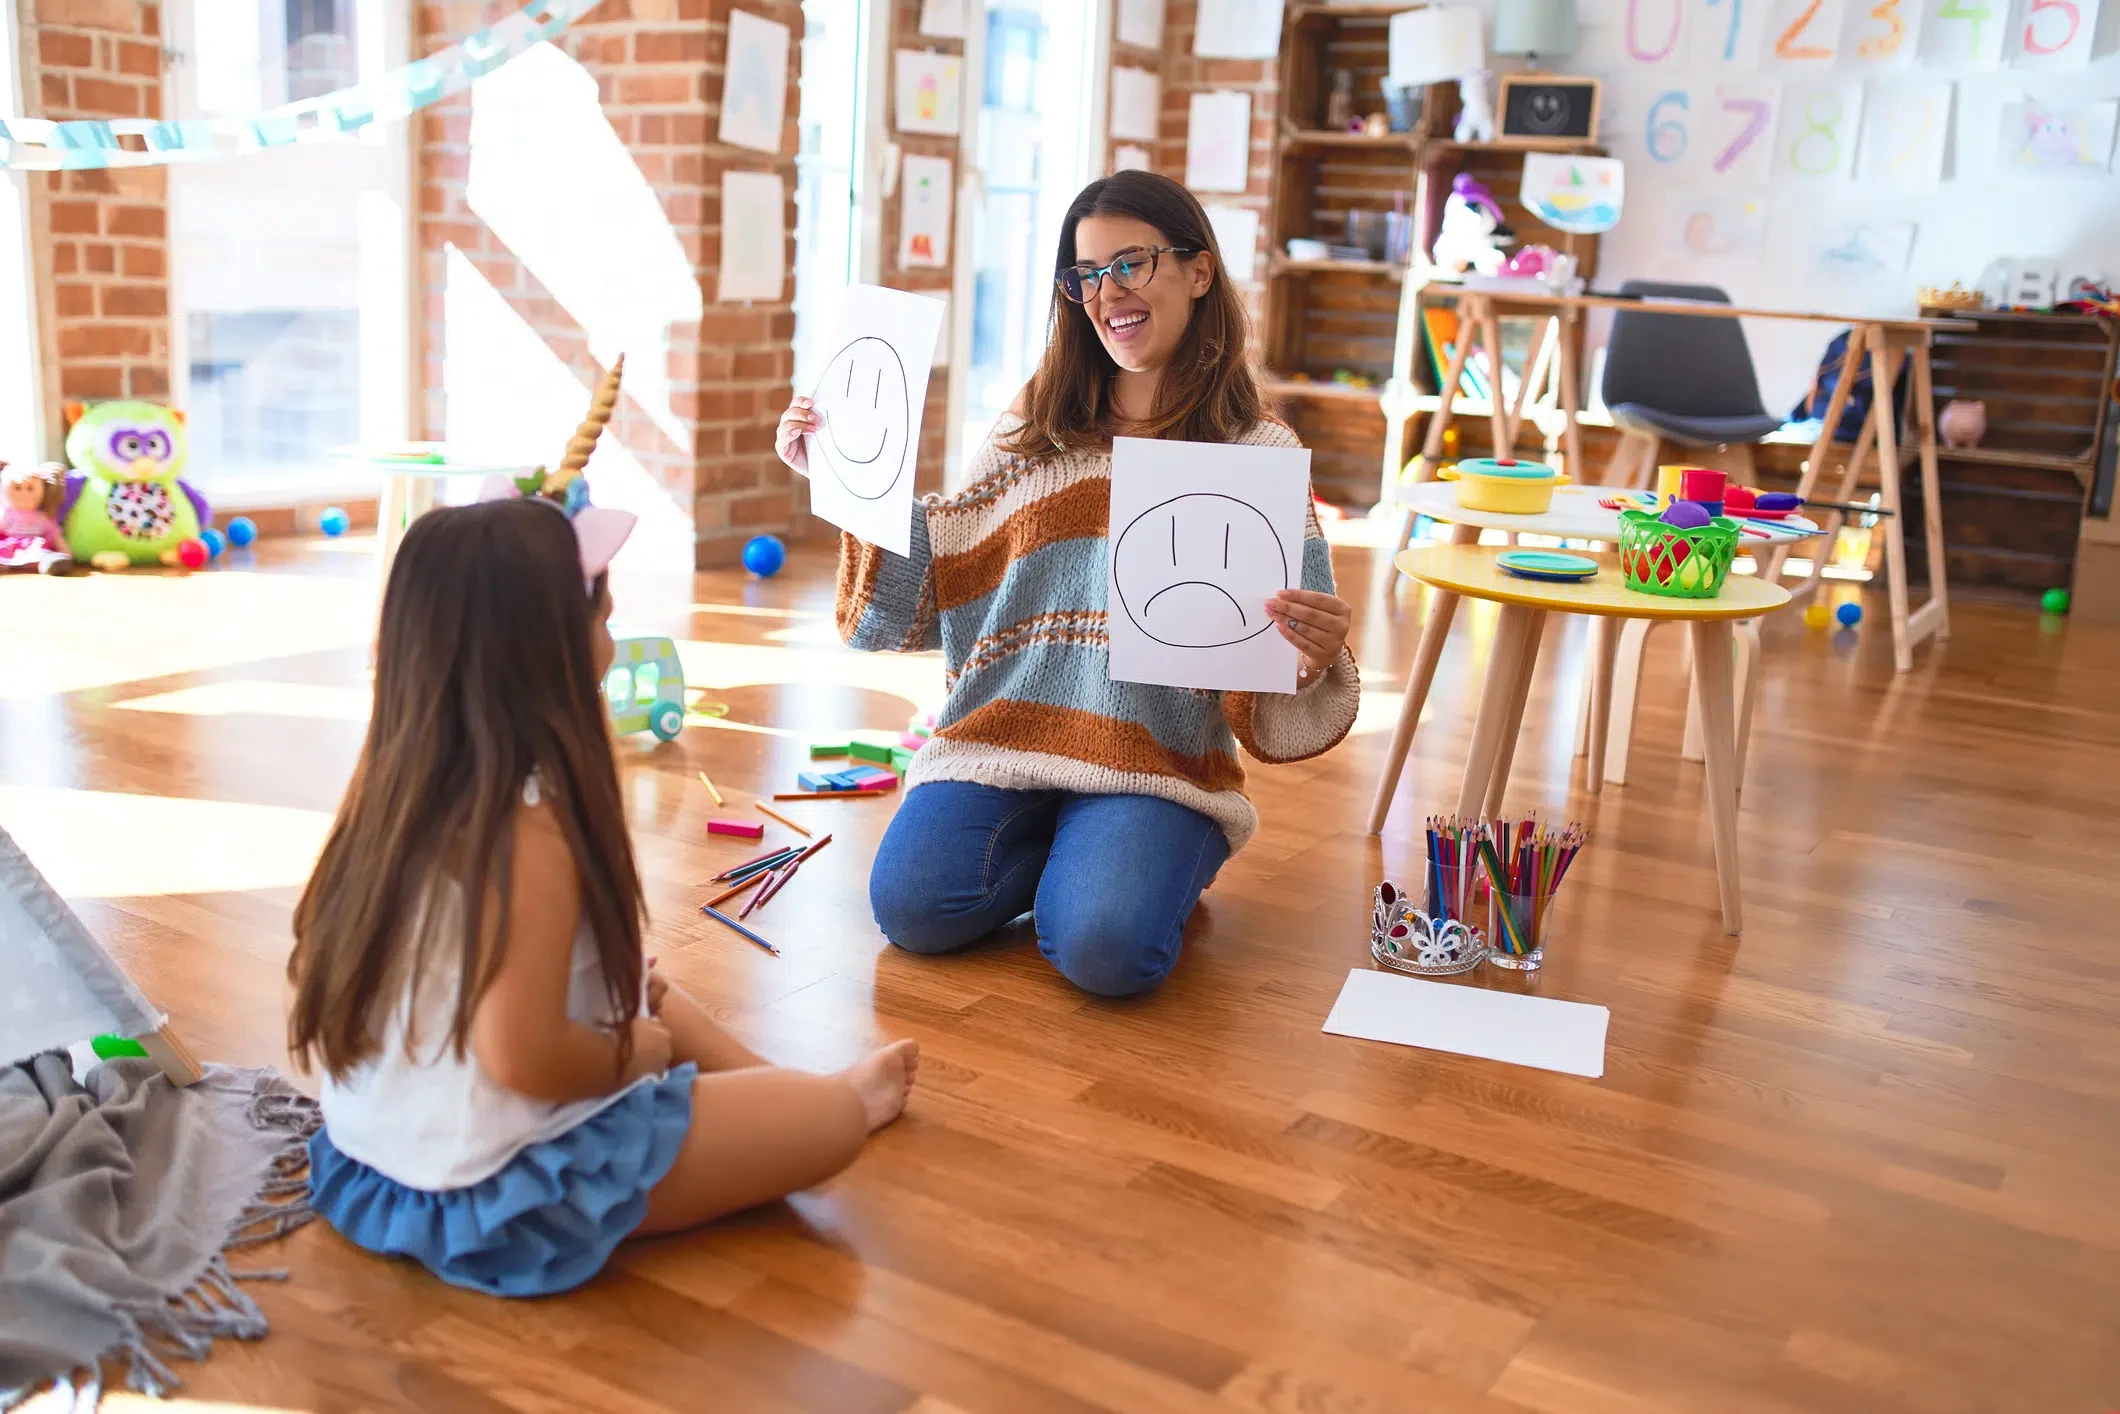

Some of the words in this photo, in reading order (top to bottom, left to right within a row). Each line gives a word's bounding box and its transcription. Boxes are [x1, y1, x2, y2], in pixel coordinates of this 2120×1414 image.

[1625, 0, 1683, 63] 0
[1706, 0, 1743, 61] 1
[1774, 0, 1833, 59] 2
[1858, 0, 1905, 60] 3
[1938, 0, 1991, 59] 4
[2023, 0, 2081, 55] 5
[1645, 90, 1690, 163] 6
[1712, 97, 1772, 174] 7
[1790, 92, 1843, 175] 8
[1888, 98, 1934, 169] 9
